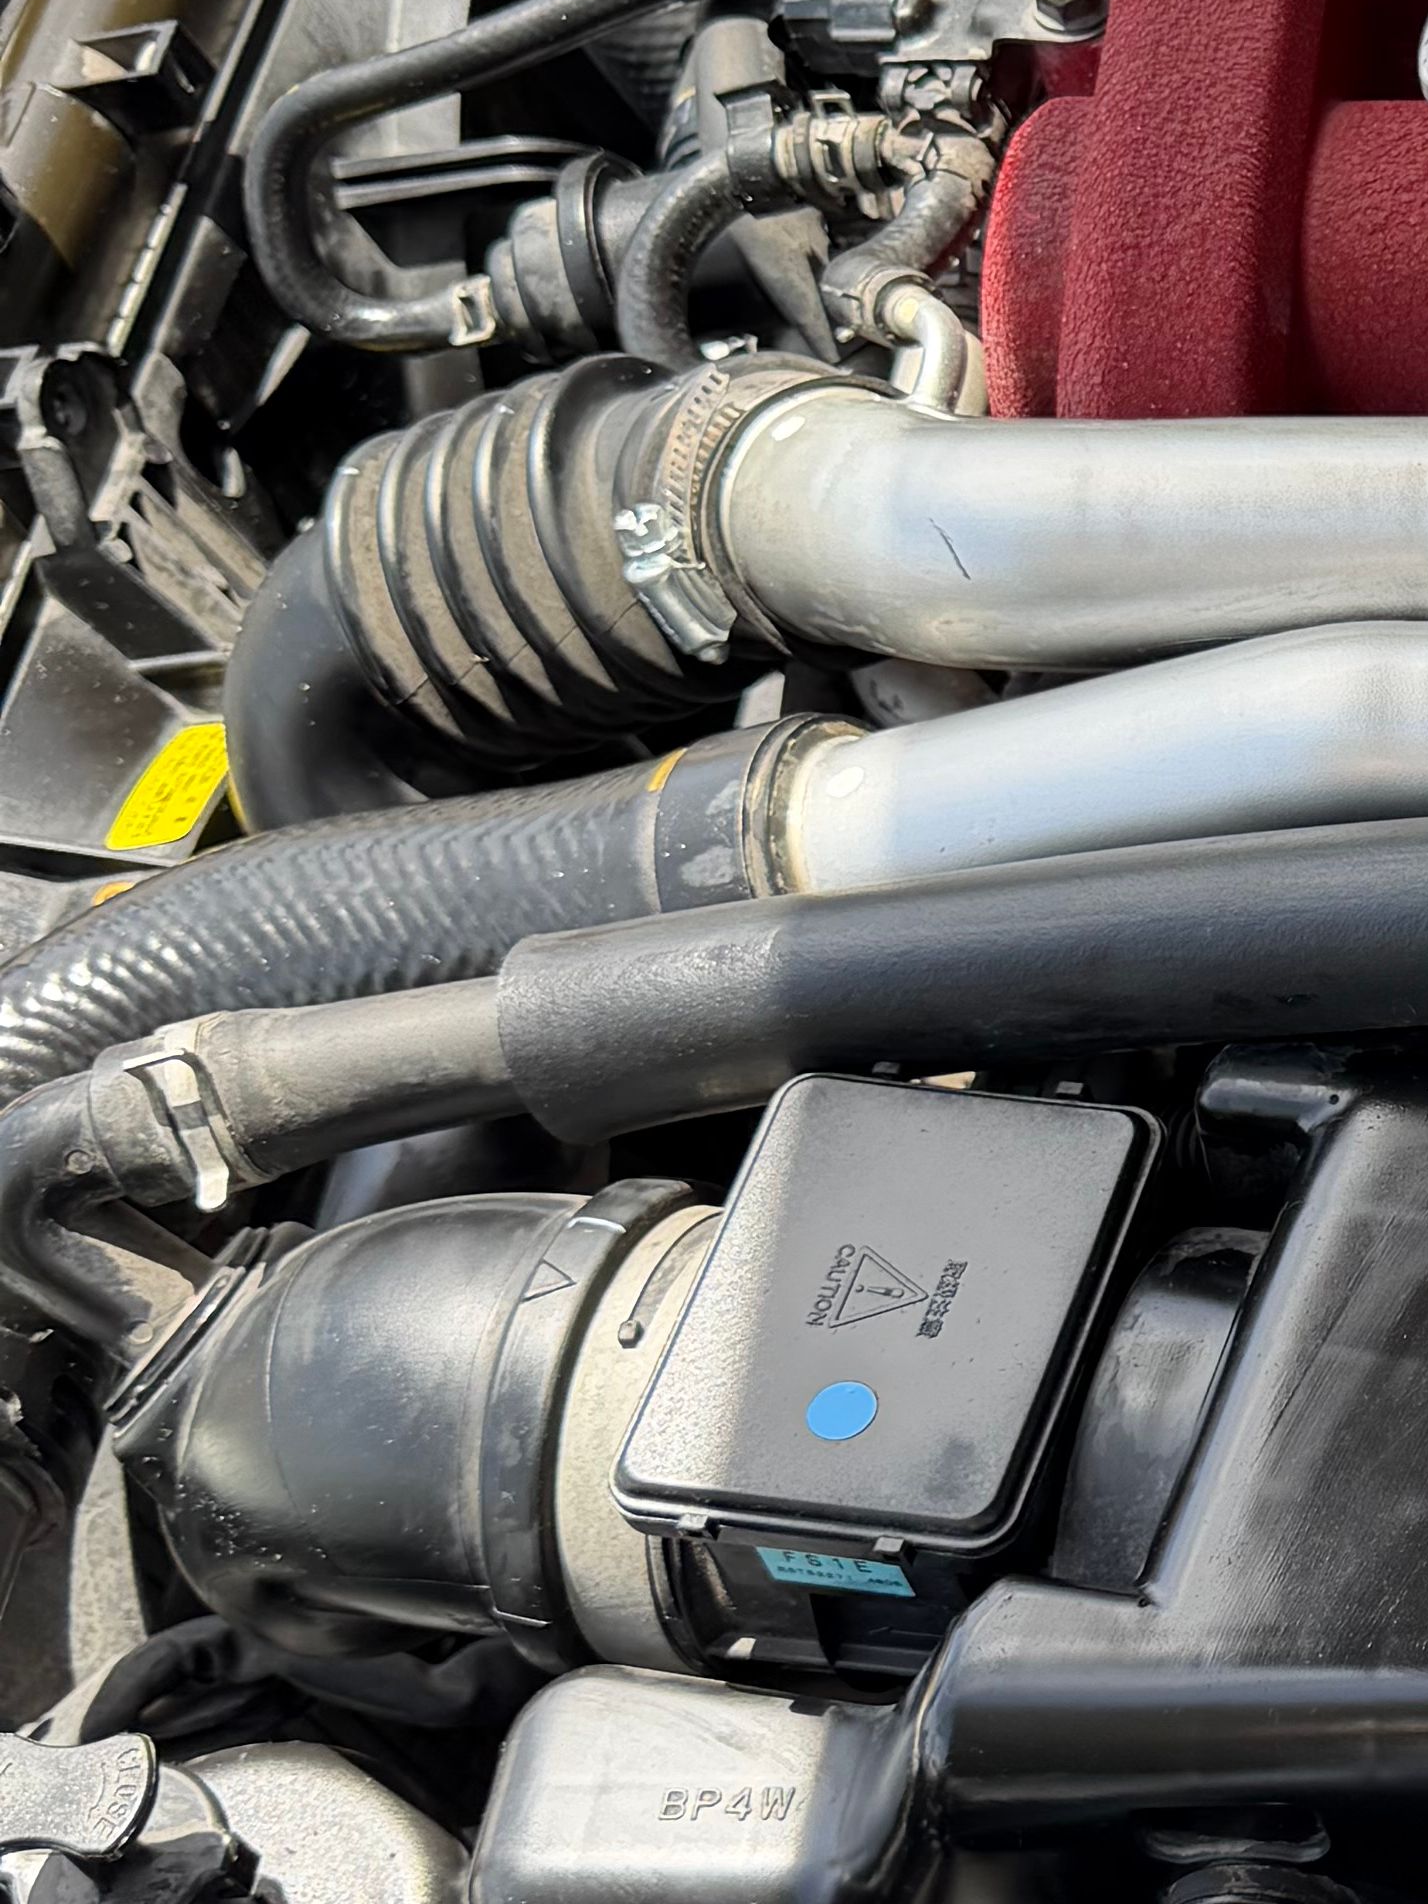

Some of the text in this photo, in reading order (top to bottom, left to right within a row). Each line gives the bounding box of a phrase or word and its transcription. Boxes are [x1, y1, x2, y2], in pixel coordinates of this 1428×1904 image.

[804, 1242, 857, 1329] CAUTION
[91, 1747, 144, 1840] CLOSE
[656, 1783, 797, 1823] BP4W
